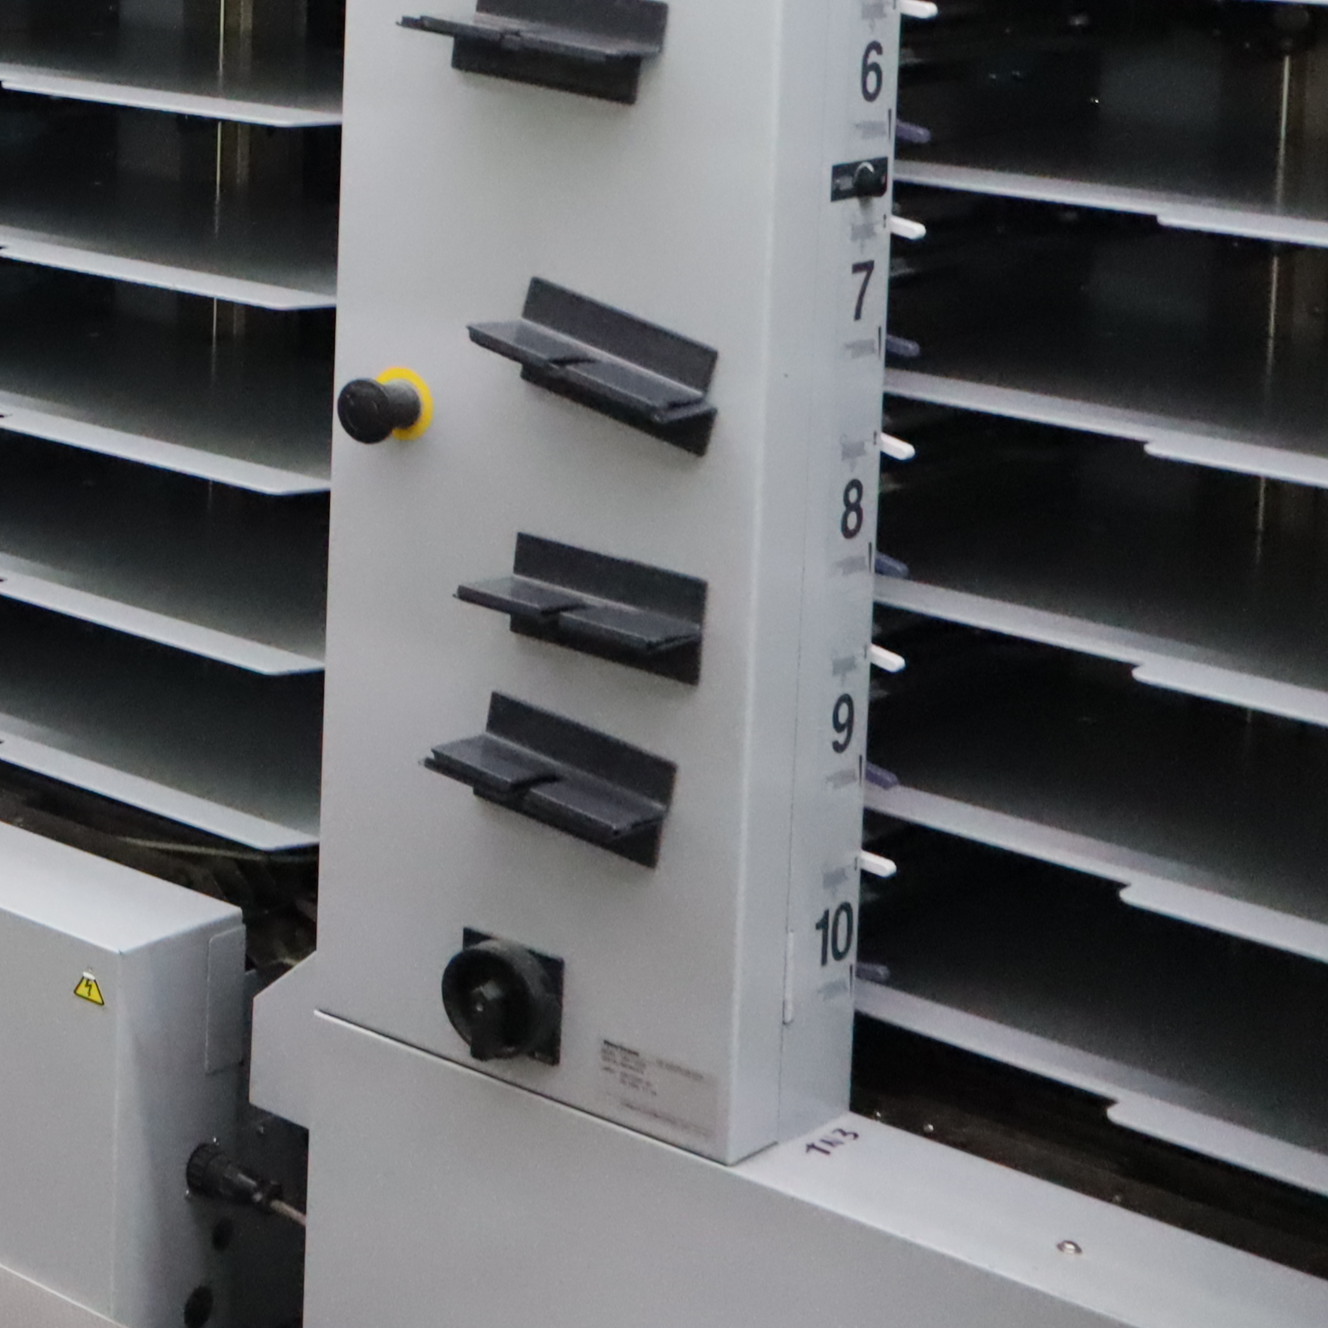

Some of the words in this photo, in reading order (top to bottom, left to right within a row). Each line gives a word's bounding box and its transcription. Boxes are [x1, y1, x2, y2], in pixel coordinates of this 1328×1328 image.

[860, 40, 883, 103] 6
[851, 259, 875, 321] 7
[840, 478, 864, 540] 8
[831, 693, 855, 754] 9
[814, 900, 855, 967] 10
